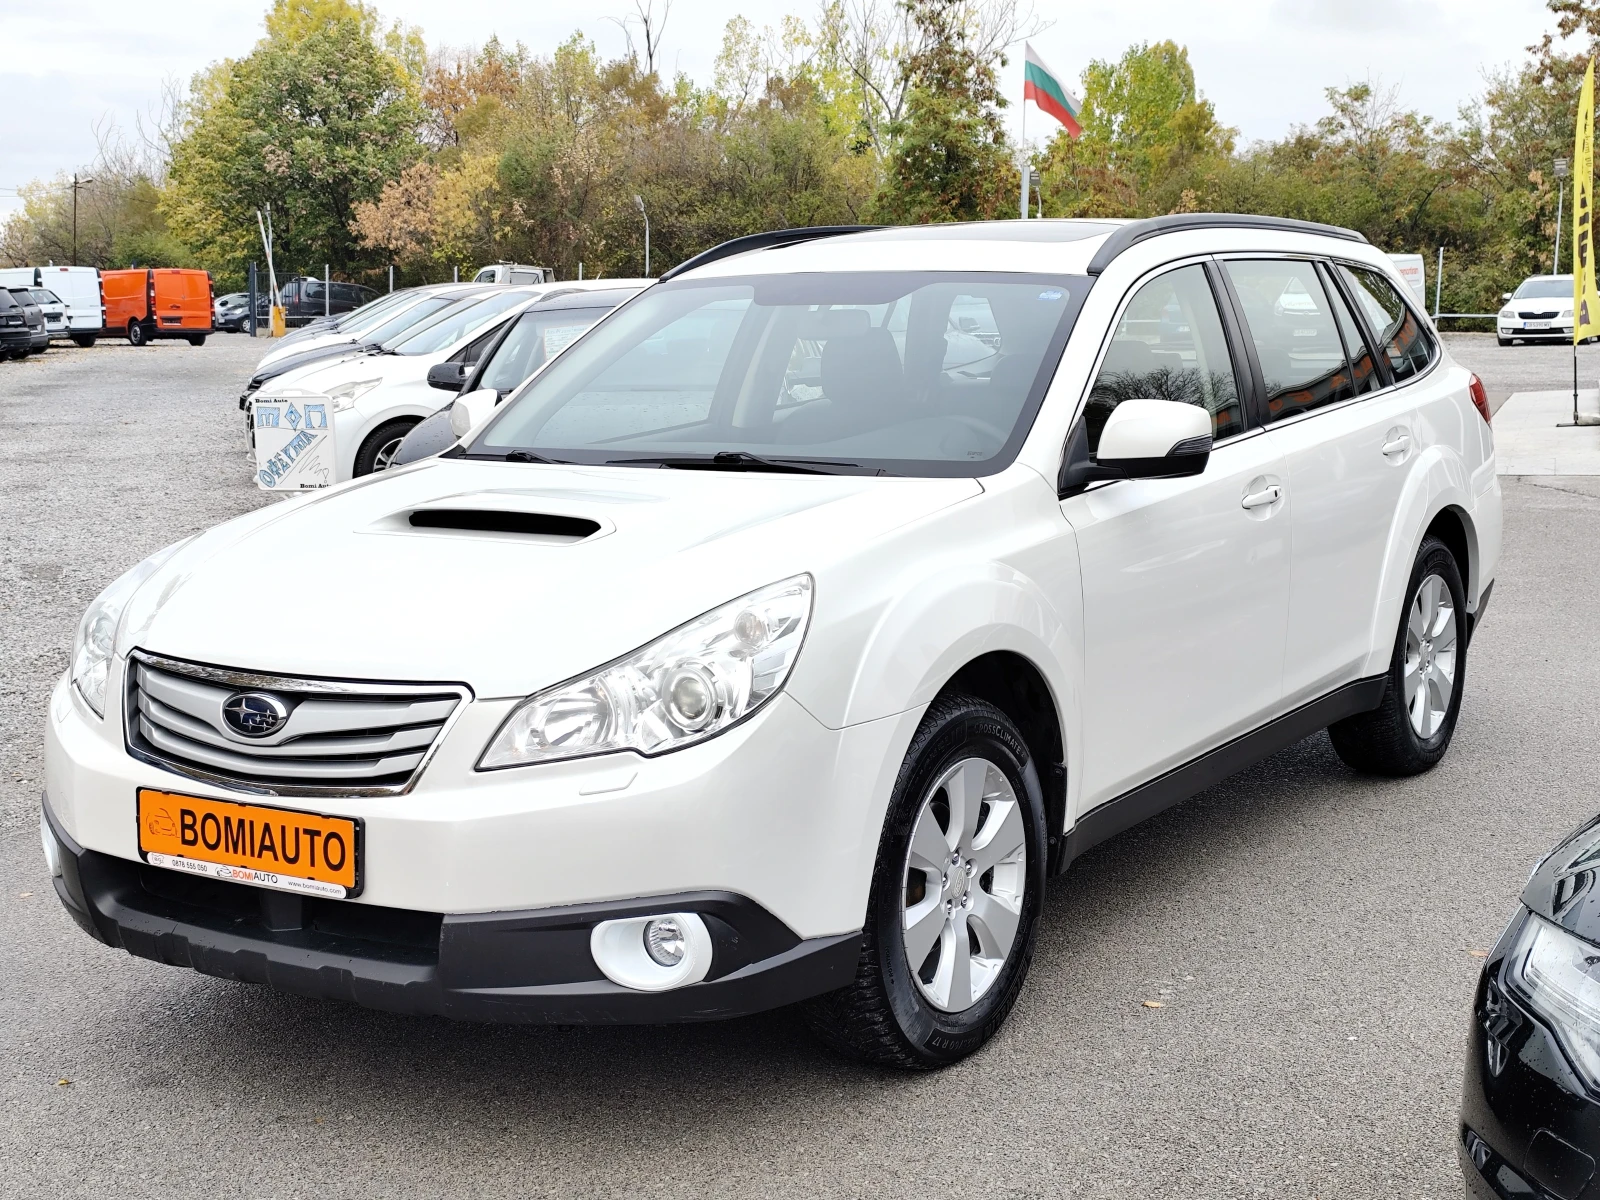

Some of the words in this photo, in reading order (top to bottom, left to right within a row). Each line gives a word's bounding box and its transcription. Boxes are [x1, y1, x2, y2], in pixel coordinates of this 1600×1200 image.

[180, 808, 346, 872] BOMIAUTO
[172, 859, 186, 868] 0878
[186, 861, 196, 870] 555
[197, 863, 208, 872] 050
[232, 868, 278, 884] BOMIAUTO
[288, 880, 342, 895] www.bomiauto.com
